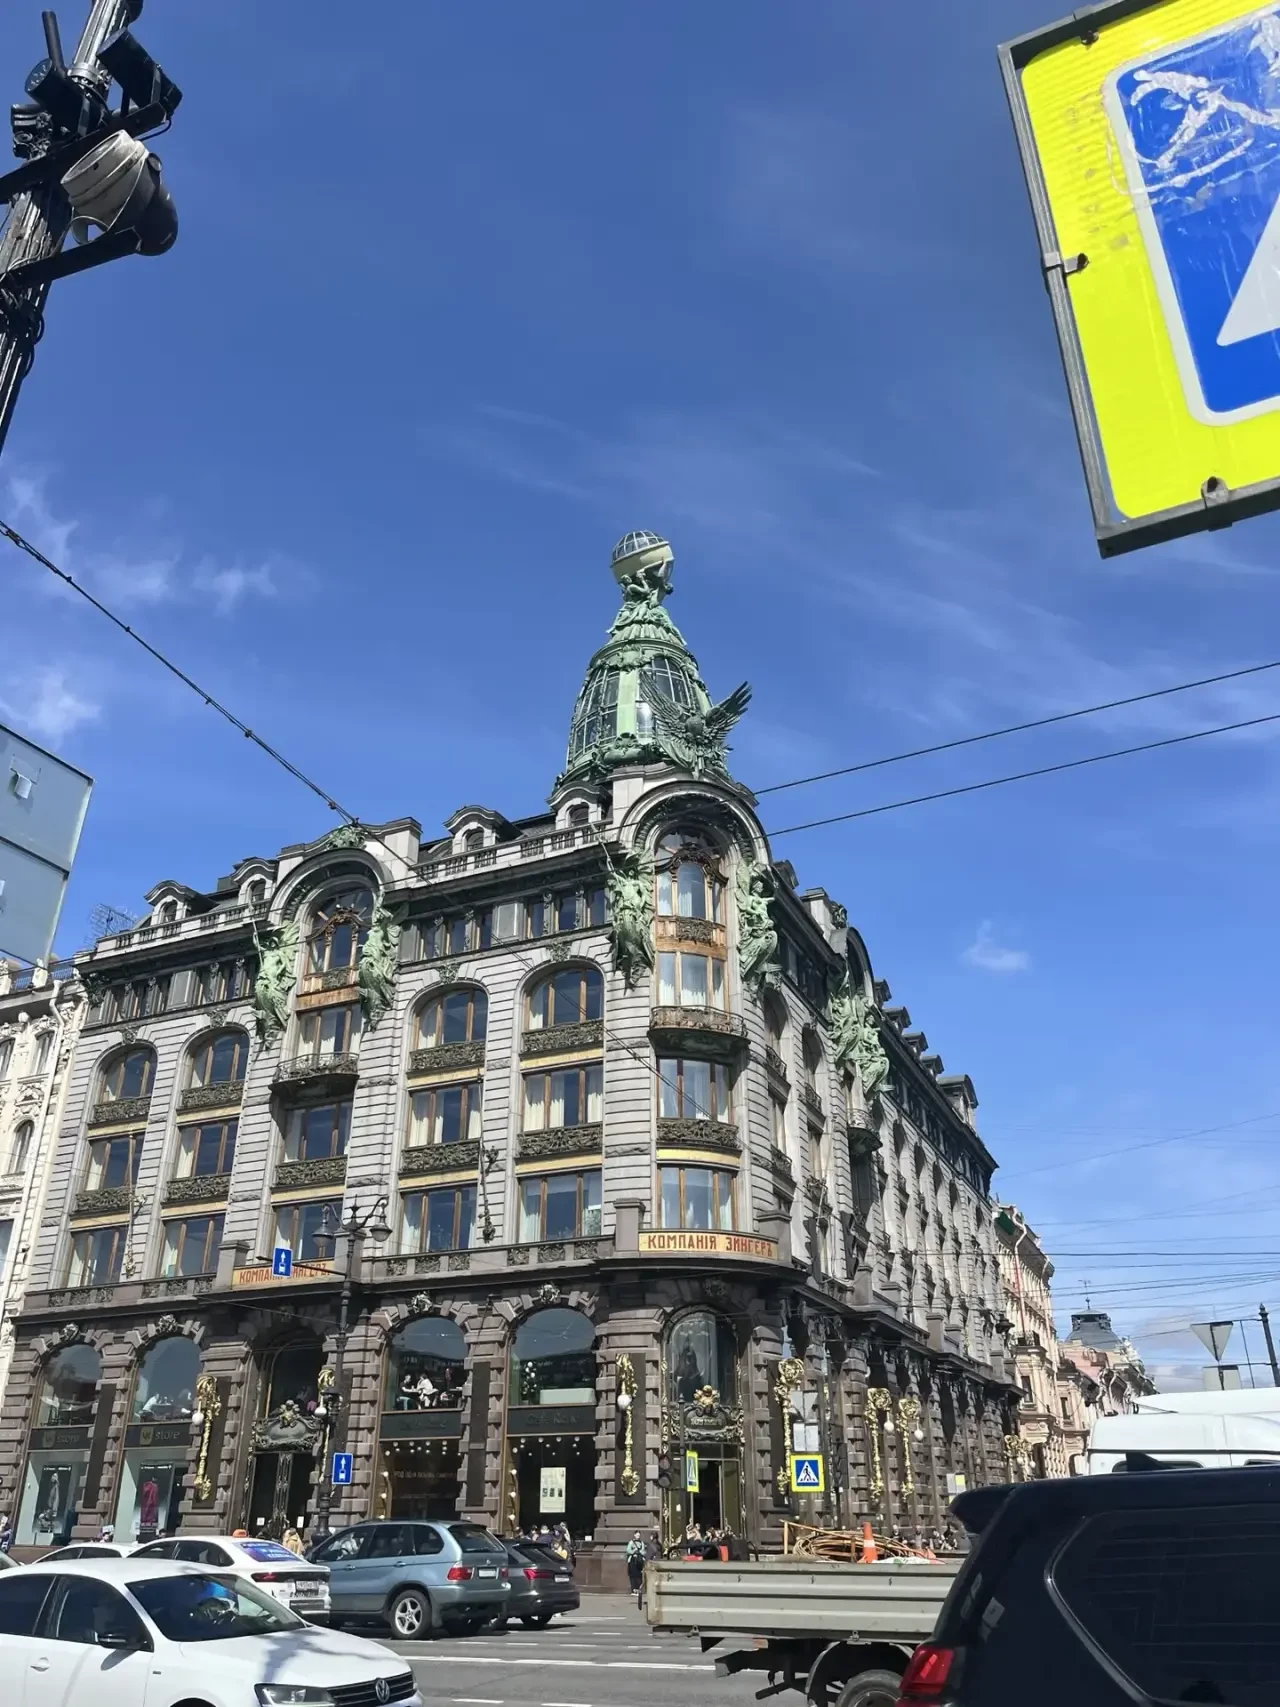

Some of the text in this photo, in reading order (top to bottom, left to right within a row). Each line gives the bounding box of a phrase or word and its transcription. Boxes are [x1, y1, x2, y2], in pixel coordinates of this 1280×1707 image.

[648, 1234, 773, 1257] КОМПАНІЯ ЗИНГЕРЪ
[239, 1268, 283, 1283] КОМПА
